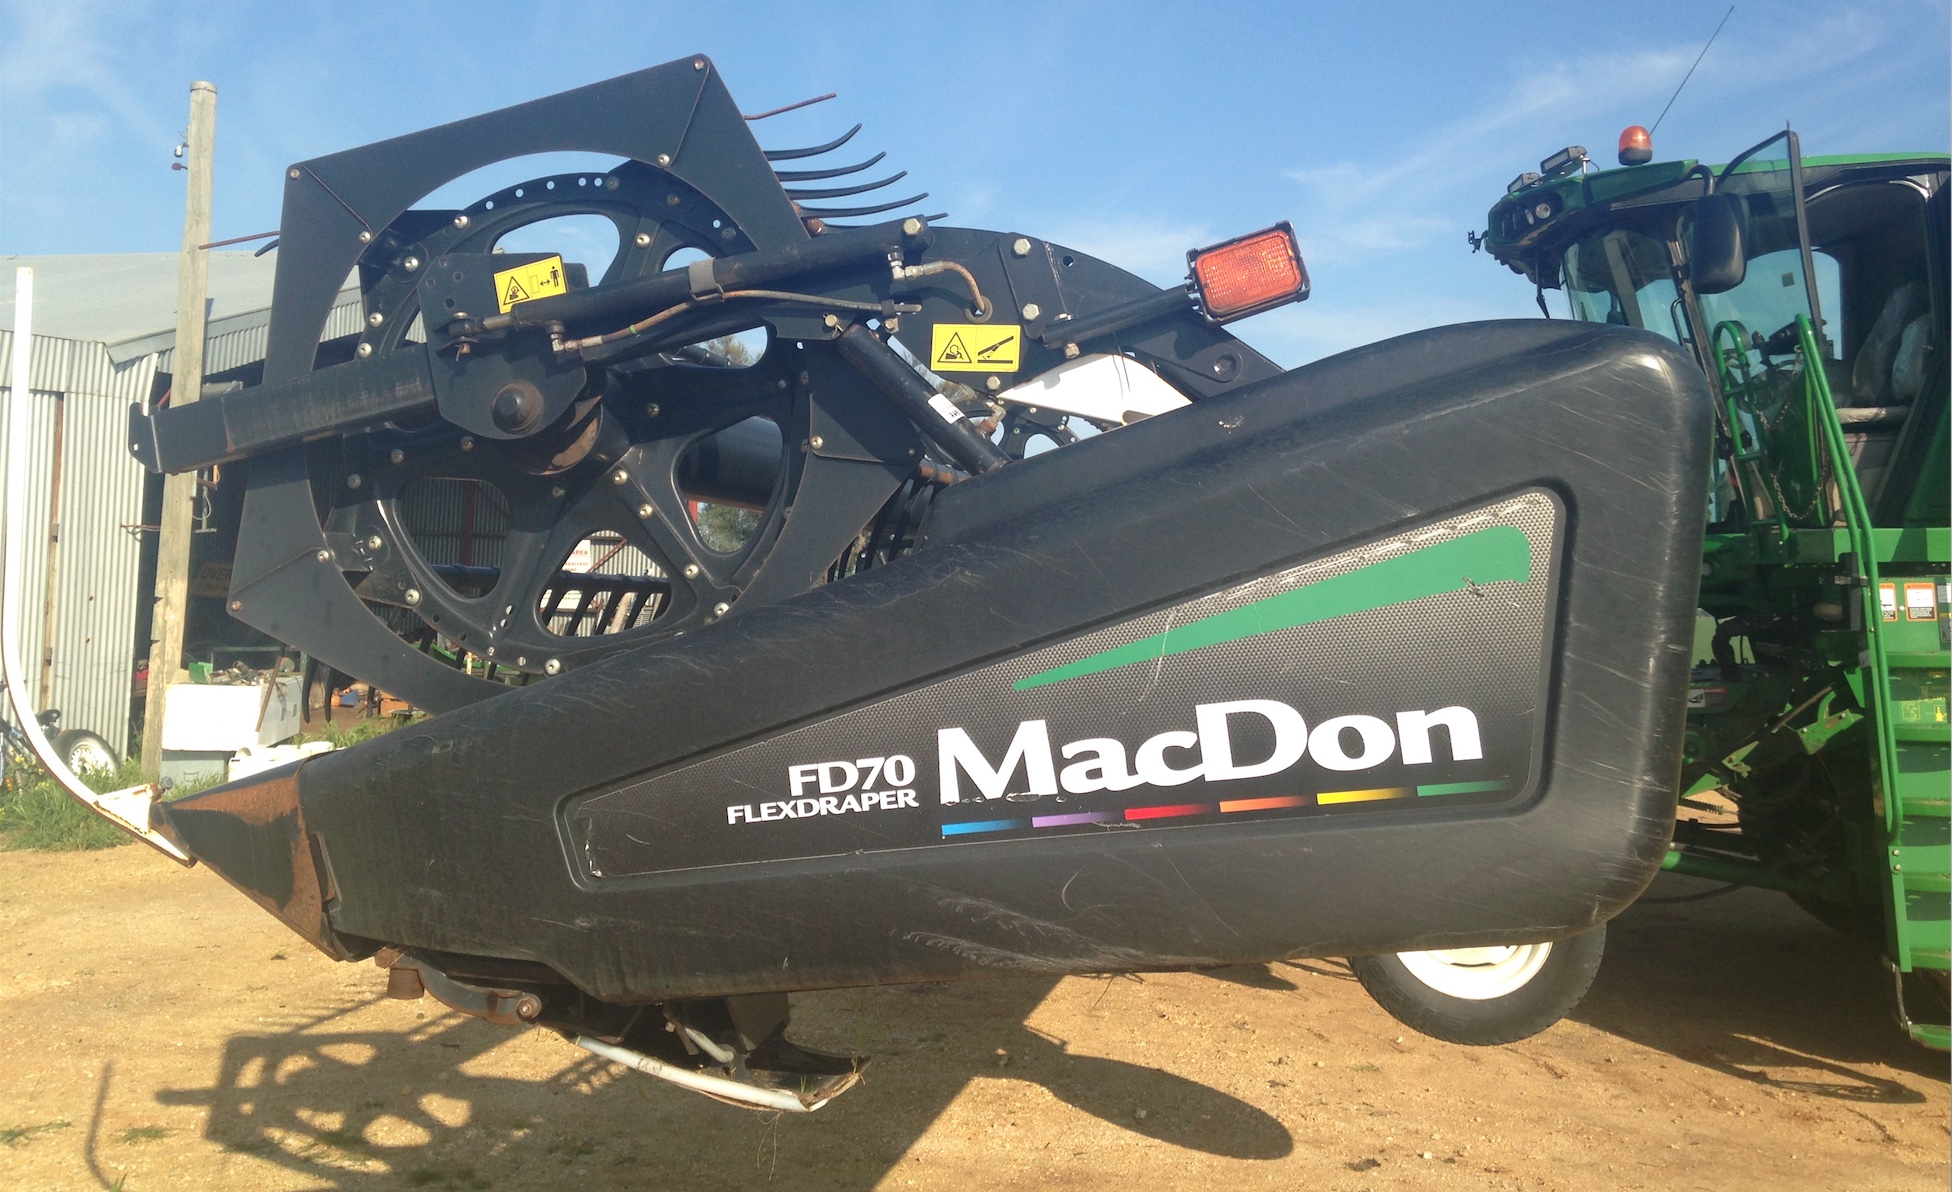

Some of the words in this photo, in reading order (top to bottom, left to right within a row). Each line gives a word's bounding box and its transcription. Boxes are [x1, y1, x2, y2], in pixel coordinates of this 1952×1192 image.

[938, 699, 1483, 806] MacDon
[789, 755, 915, 796] FD70
[727, 789, 919, 824] FLEXDRAPER
